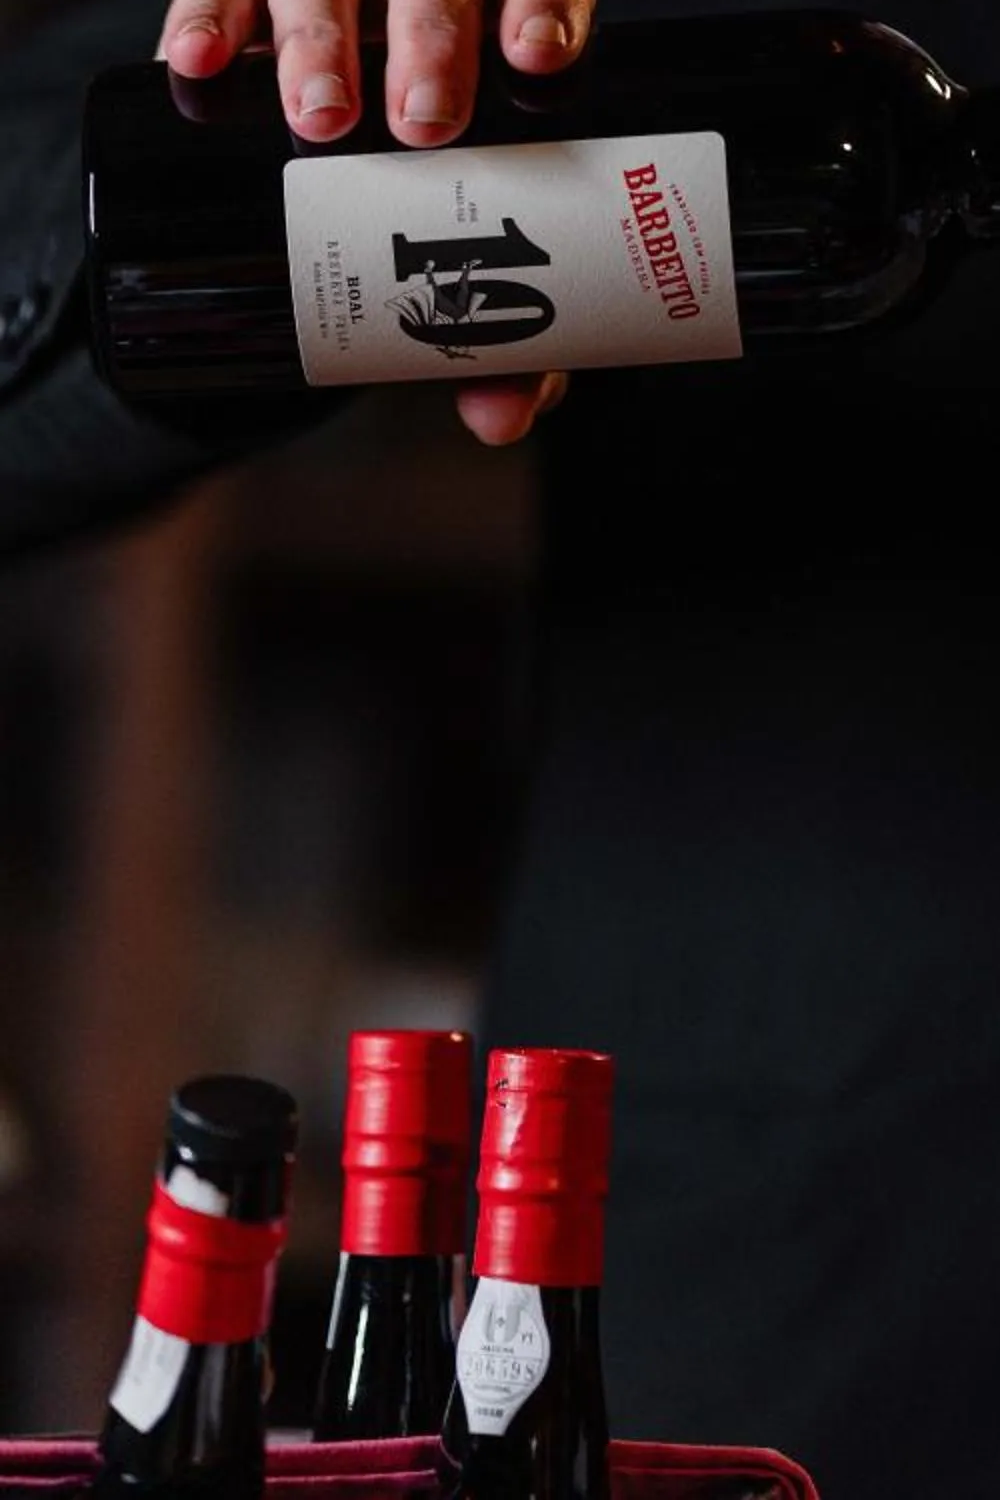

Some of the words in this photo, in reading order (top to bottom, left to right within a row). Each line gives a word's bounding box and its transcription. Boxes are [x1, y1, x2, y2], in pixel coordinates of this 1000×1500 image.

[392, 217, 556, 348] 10
[619, 217, 651, 294] MADEIRA
[623, 163, 702, 322] BARBEITO
[345, 275, 364, 325] BOAL
